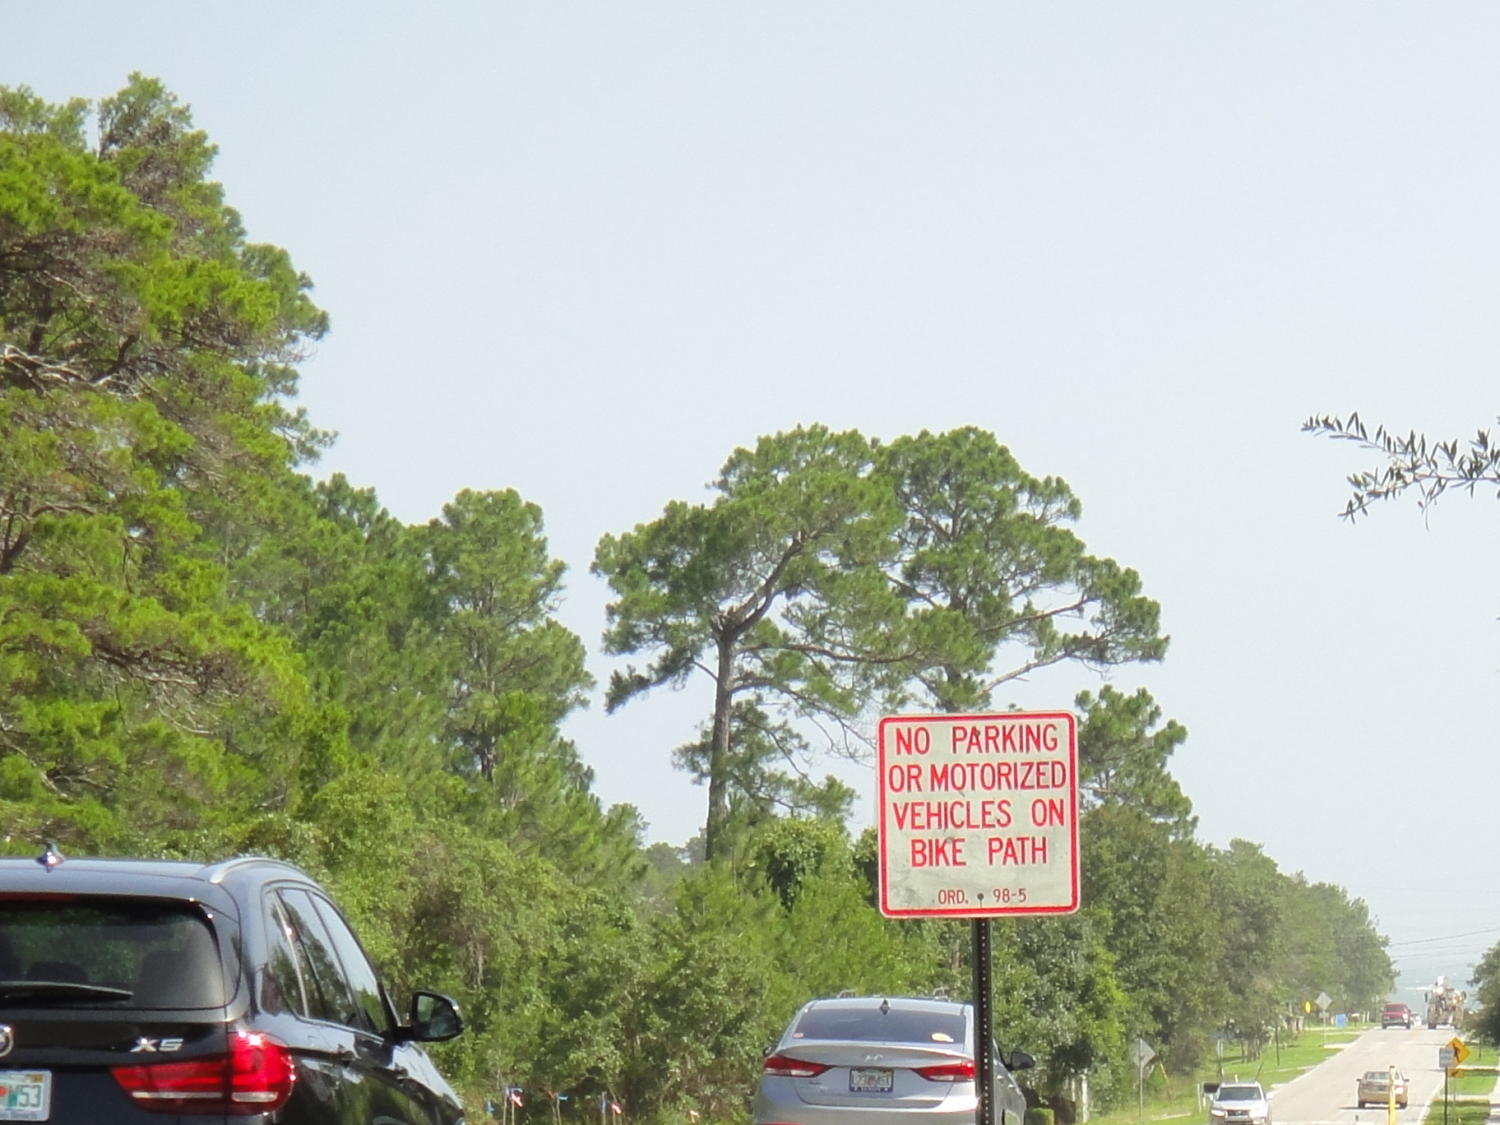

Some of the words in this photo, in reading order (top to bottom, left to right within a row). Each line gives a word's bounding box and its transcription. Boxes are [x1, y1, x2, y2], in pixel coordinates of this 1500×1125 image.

[896, 726, 930, 755] NO
[952, 724, 1058, 754] PARKING
[889, 765, 922, 793] OR
[930, 761, 1067, 792] MOTORIZED
[893, 799, 1011, 830] VEHICLES
[1031, 798, 1064, 827] ON
[911, 838, 966, 867] BIKE
[988, 837, 1047, 866] PATH
[938, 889, 969, 904] ORD.
[993, 888, 1027, 903] 98-5
[130, 1036, 184, 1052] X5
